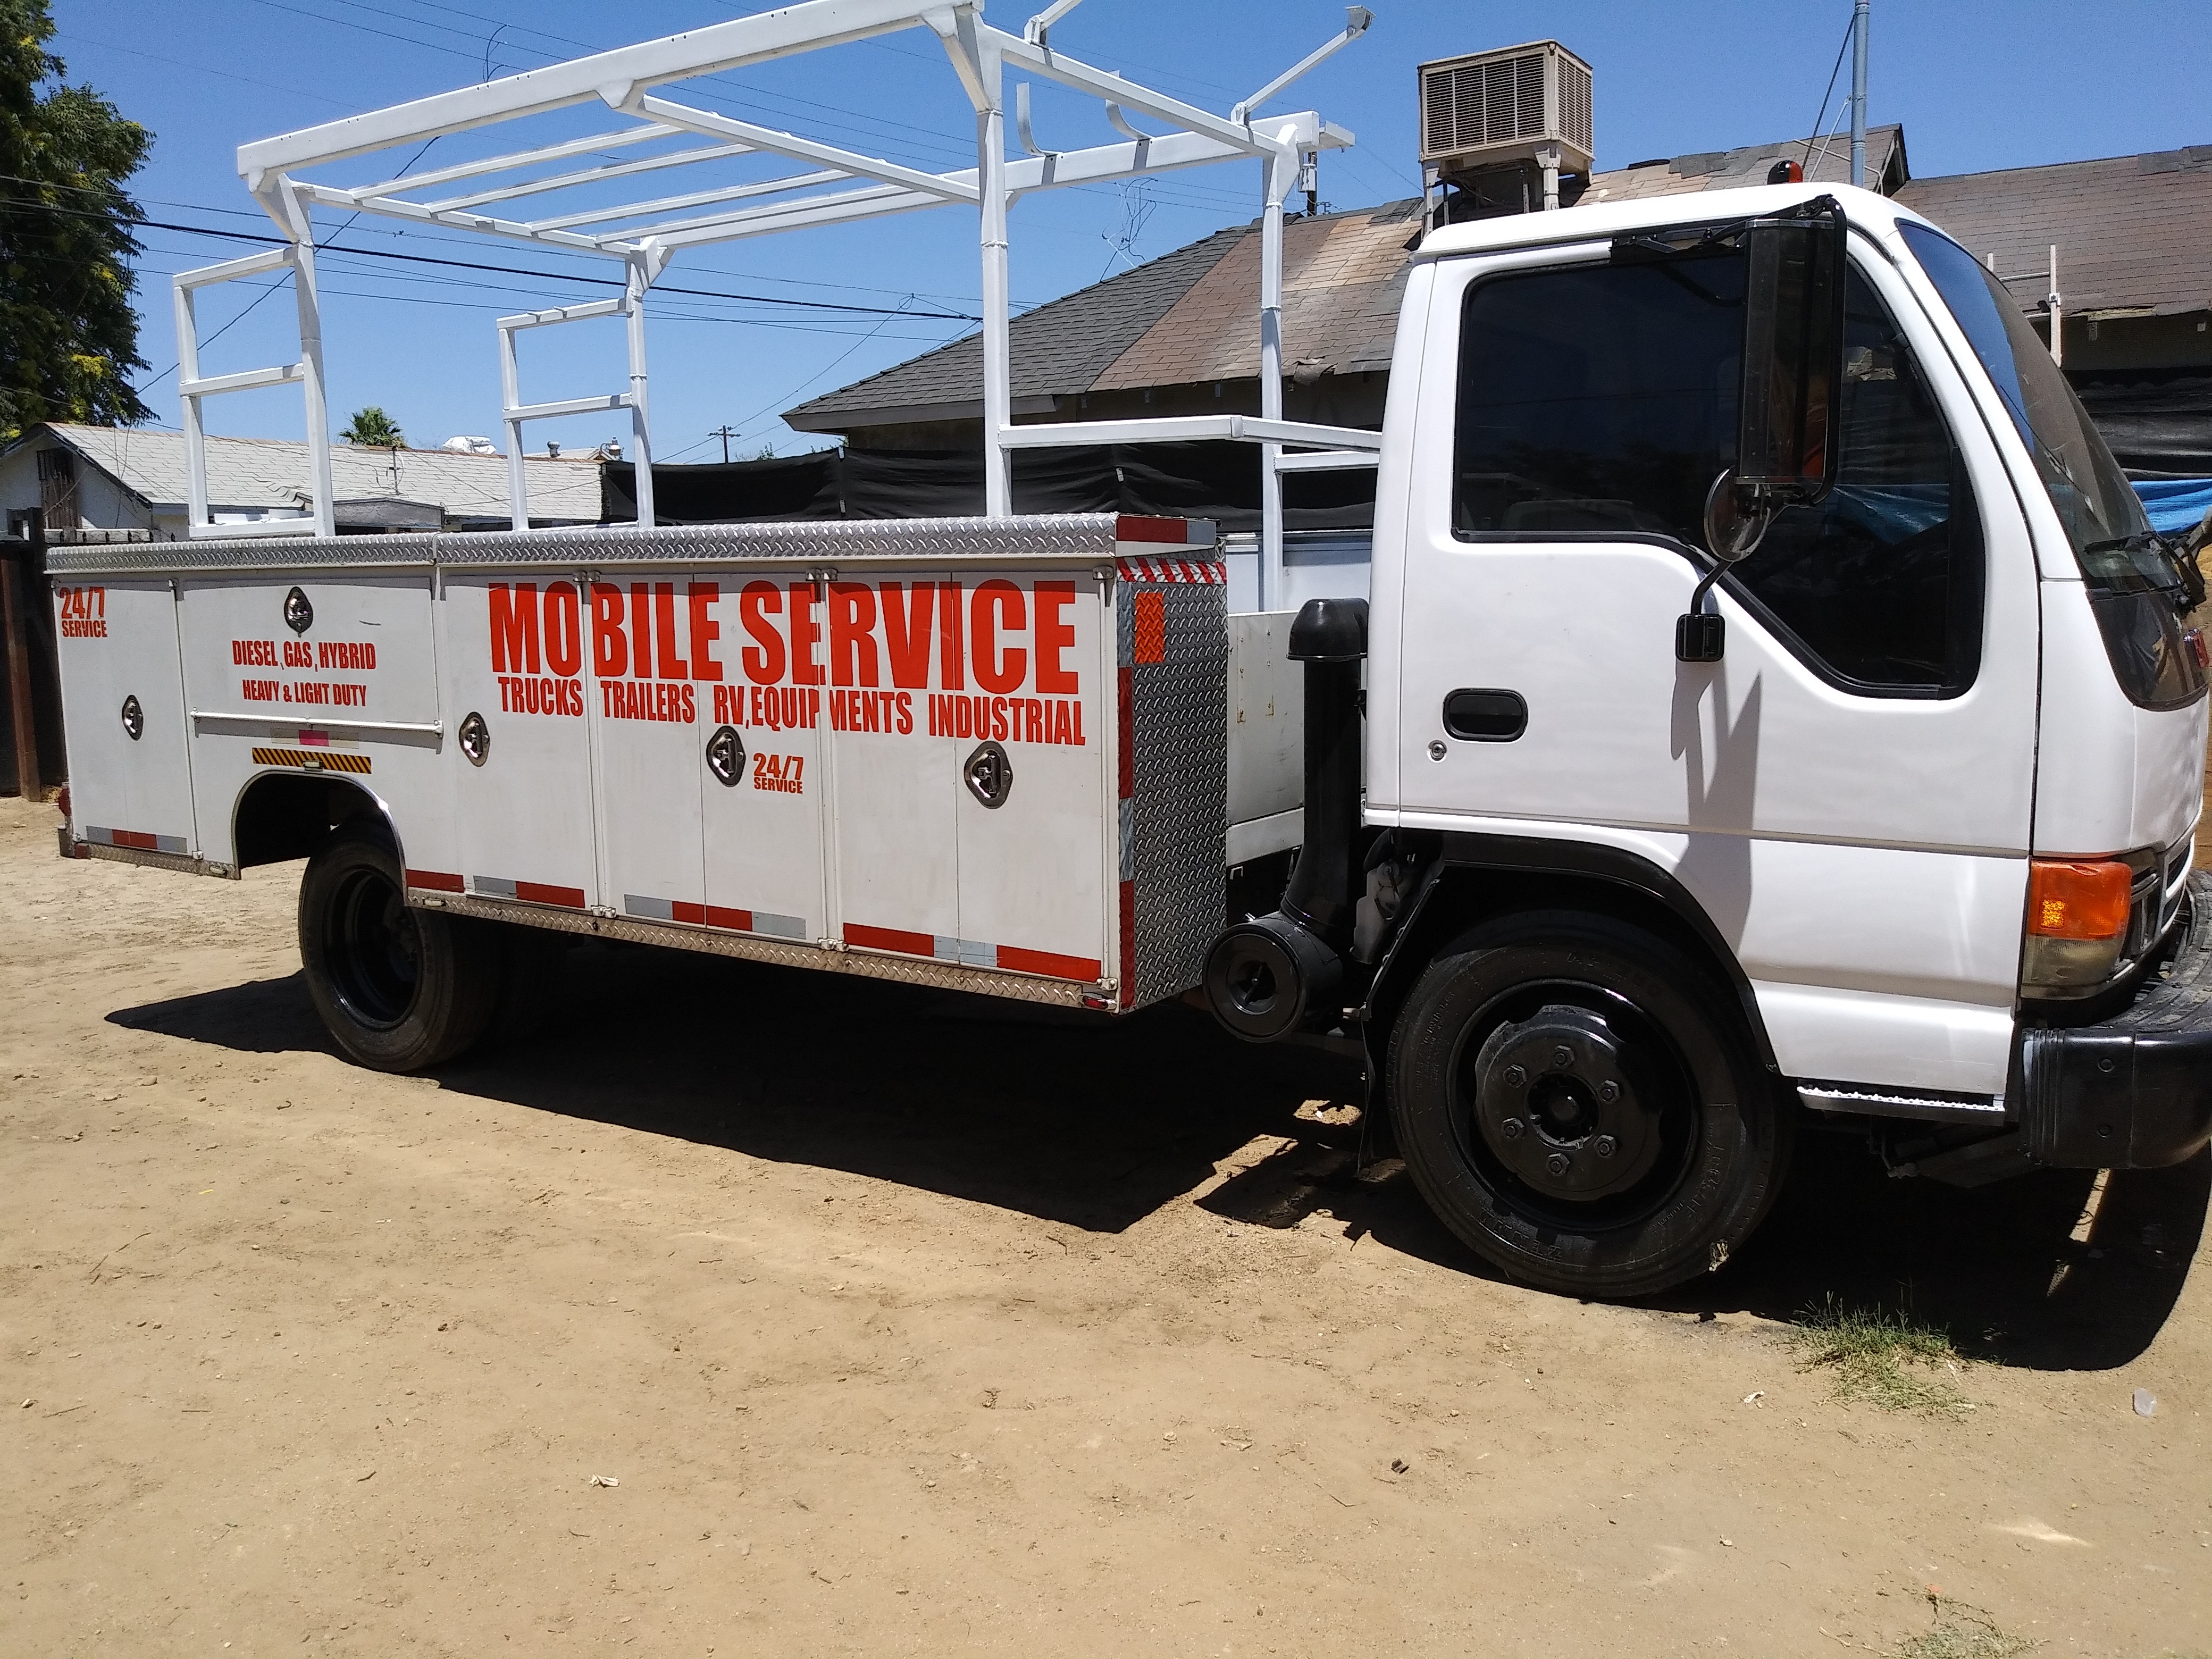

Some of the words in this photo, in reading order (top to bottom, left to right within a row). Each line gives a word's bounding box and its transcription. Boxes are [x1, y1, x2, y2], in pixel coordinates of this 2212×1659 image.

[60, 586, 105, 619] 24/7
[62, 620, 108, 638] SERVICE
[488, 581, 724, 682] MOBILE
[740, 580, 1079, 695] SERVICE
[318, 642, 376, 669] HYBRID
[242, 679, 280, 701] HEAVY
[282, 684, 292, 702] &
[294, 682, 330, 705] LIGHT
[332, 683, 366, 707] DUTY
[498, 676, 584, 717] TRUCKS
[599, 680, 696, 724] TRAILERS
[928, 693, 1086, 746] INDUSTRIAL
[753, 752, 804, 781] 24/7
[753, 776, 803, 794] SERVICE
